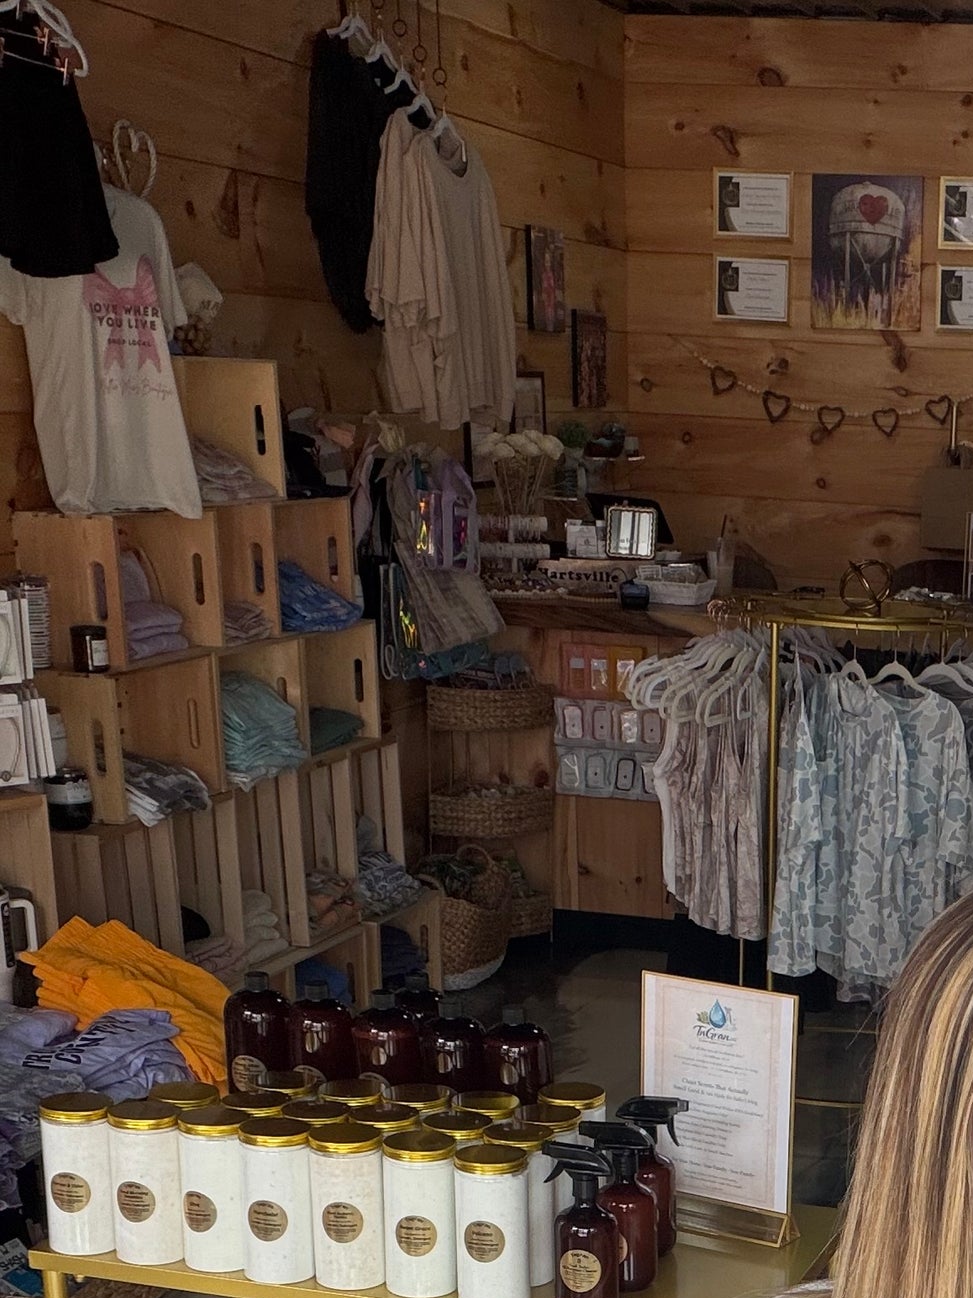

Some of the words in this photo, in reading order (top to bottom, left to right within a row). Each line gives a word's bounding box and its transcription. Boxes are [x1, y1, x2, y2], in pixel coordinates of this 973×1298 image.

[122, 304, 160, 318] WHER
[97, 316, 123, 328] YOU
[128, 318, 157, 331] LIVE
[537, 567, 620, 583] Hartsville
